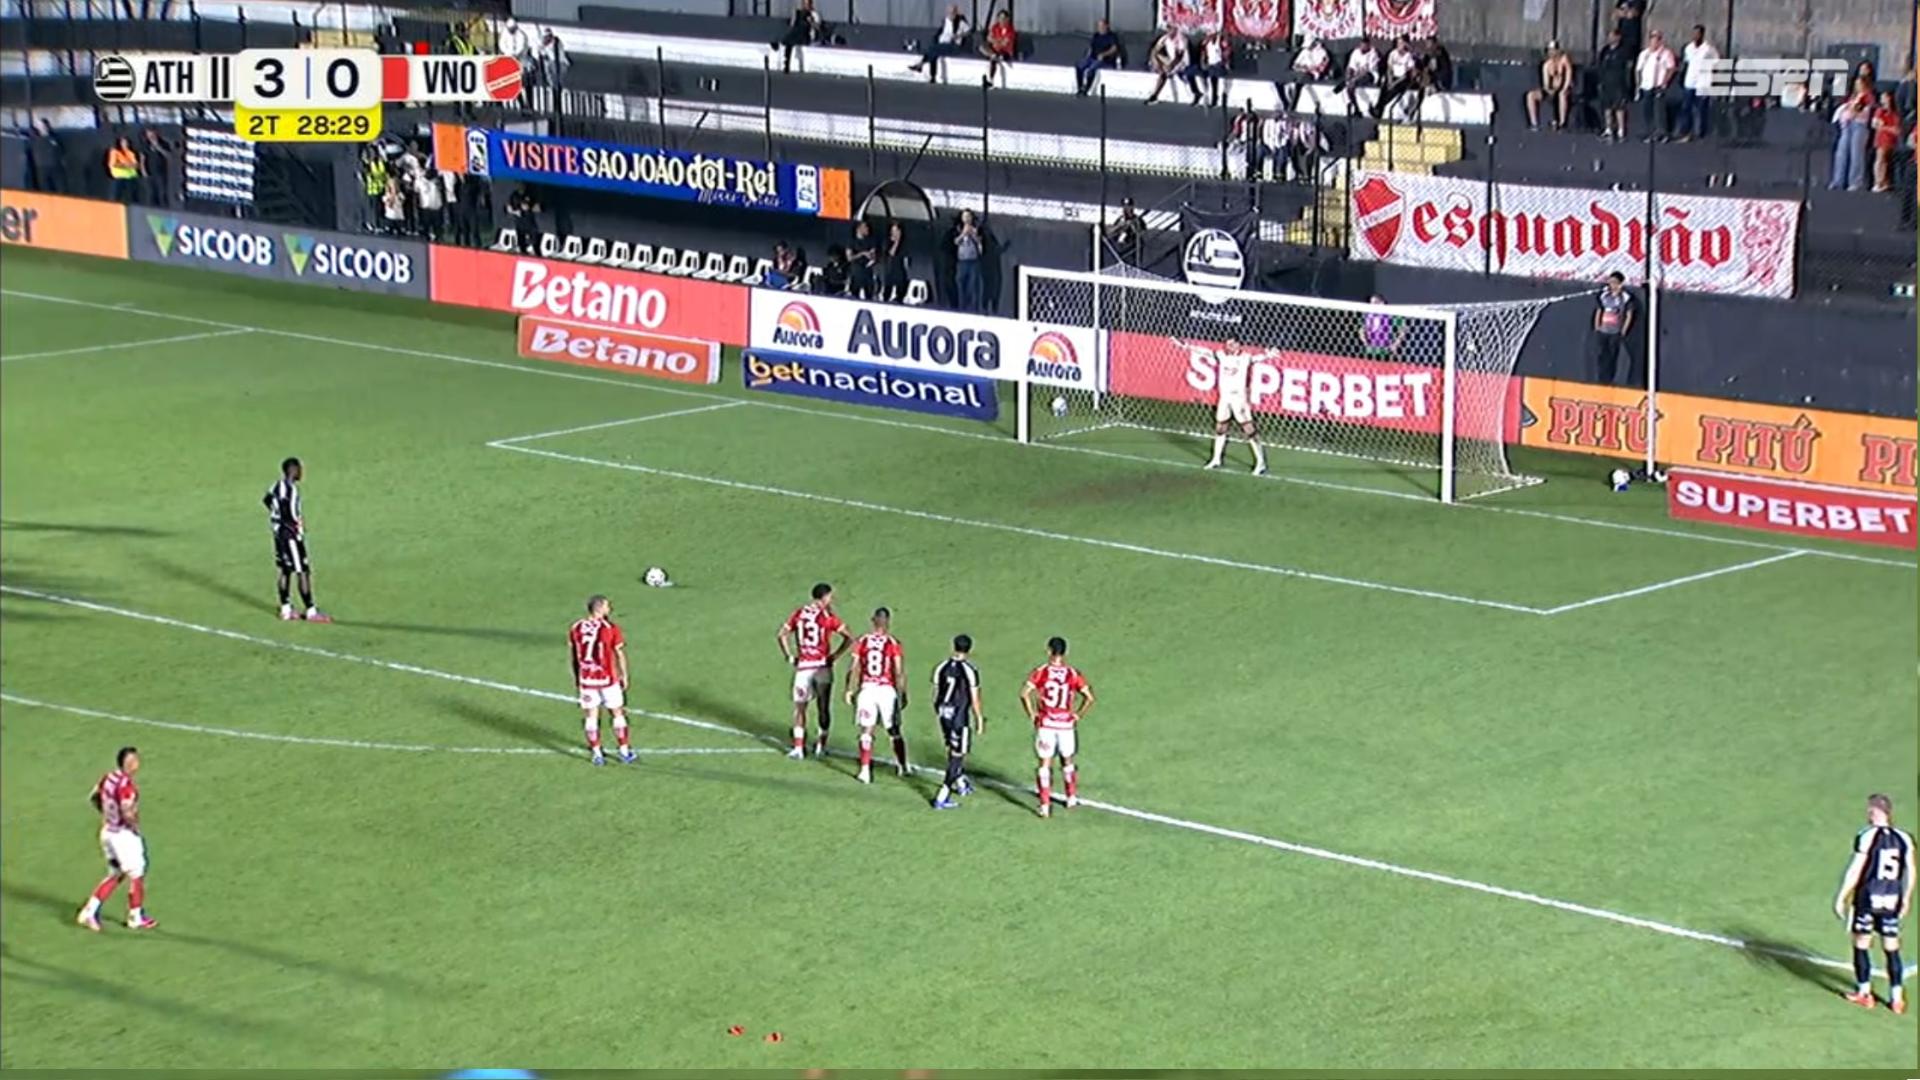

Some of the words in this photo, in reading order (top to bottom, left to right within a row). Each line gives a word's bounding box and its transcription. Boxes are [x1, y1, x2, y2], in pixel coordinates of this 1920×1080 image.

[502, 139, 580, 174] VISITE
[178, 225, 273, 266] SICOOB
[1412, 195, 1732, 270] esquadrão
[314, 243, 411, 284] SICOOB
[512, 260, 667, 329] Betano
[530, 325, 698, 374] Betano
[773, 326, 824, 349] Aurora
[847, 309, 1001, 370] Aurora
[749, 356, 982, 409] betnacional
[1026, 358, 1083, 382] Aurora
[1186, 349, 1433, 419] SPERBET
[1547, 396, 1664, 454] PITÚ
[1697, 413, 1822, 473] PITÚ
[1675, 480, 1912, 534] SUPERBET
[581, 634, 599, 662] 7
[795, 620, 820, 647] 13
[866, 649, 883, 677] 8
[944, 676, 957, 703] 7
[1043, 680, 1070, 709] 31
